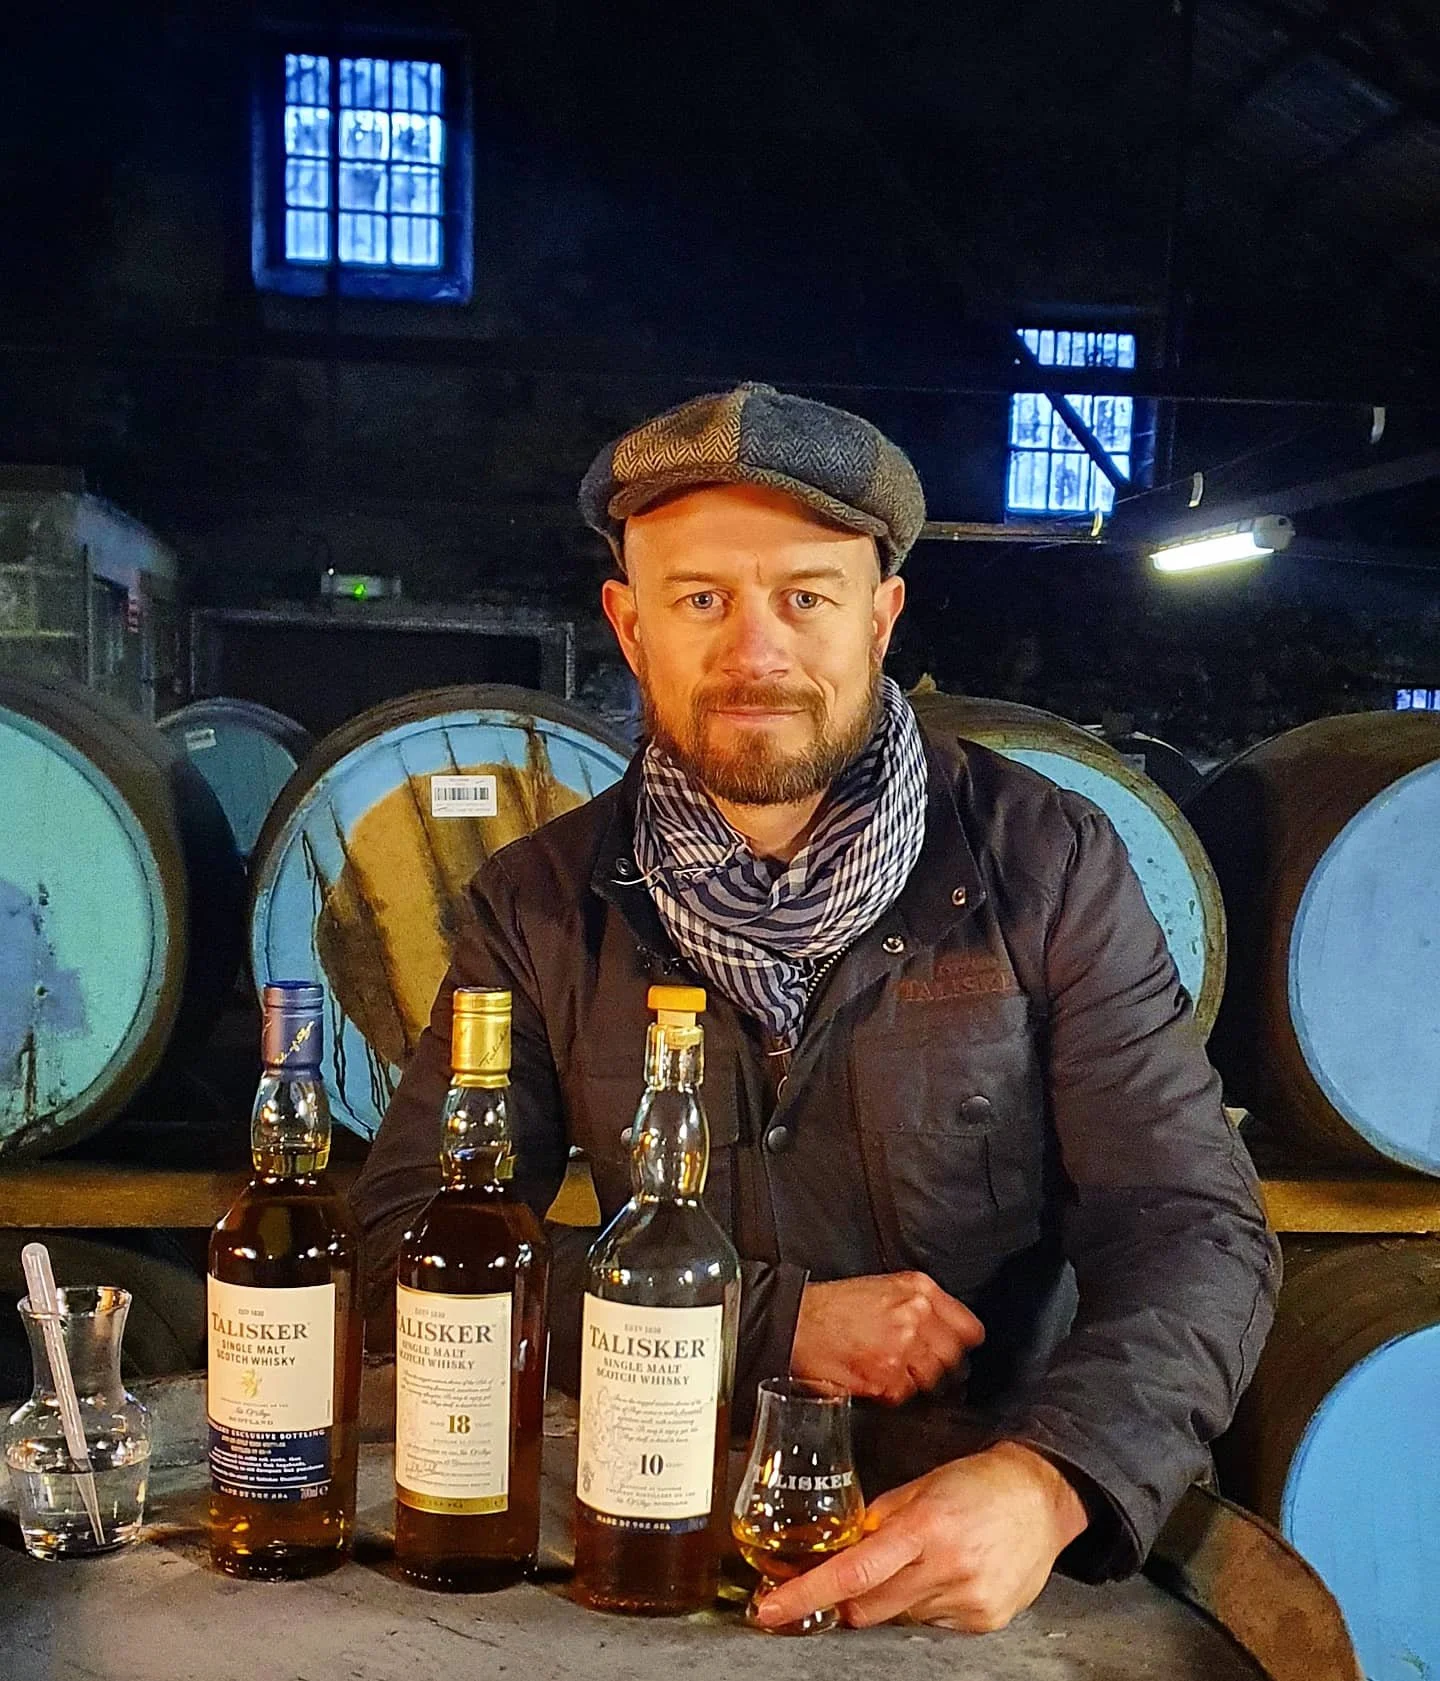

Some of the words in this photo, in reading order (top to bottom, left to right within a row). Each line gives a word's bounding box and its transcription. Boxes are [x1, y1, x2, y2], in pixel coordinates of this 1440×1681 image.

[211, 1311, 308, 1340] TALISKER
[397, 1312, 493, 1344] ALISKER
[222, 1340, 253, 1354] SINGLE
[257, 1345, 286, 1355] MALT
[589, 1324, 706, 1359] TALISKER
[216, 1348, 249, 1364] SCOTCH
[251, 1356, 295, 1366] WHISKY
[433, 1346, 466, 1358] MALT
[428, 1357, 475, 1370] WHISKY
[603, 1357, 643, 1373] SINGLE
[646, 1363, 682, 1374] MALT
[596, 1367, 637, 1383] SCOTCH
[639, 1374, 690, 1386] WHISKY
[447, 1414, 471, 1434] 18
[231, 1428, 276, 1440] EXCLUSIVE
[280, 1429, 325, 1440] BOTTLING
[640, 1454, 664, 1476] 10
